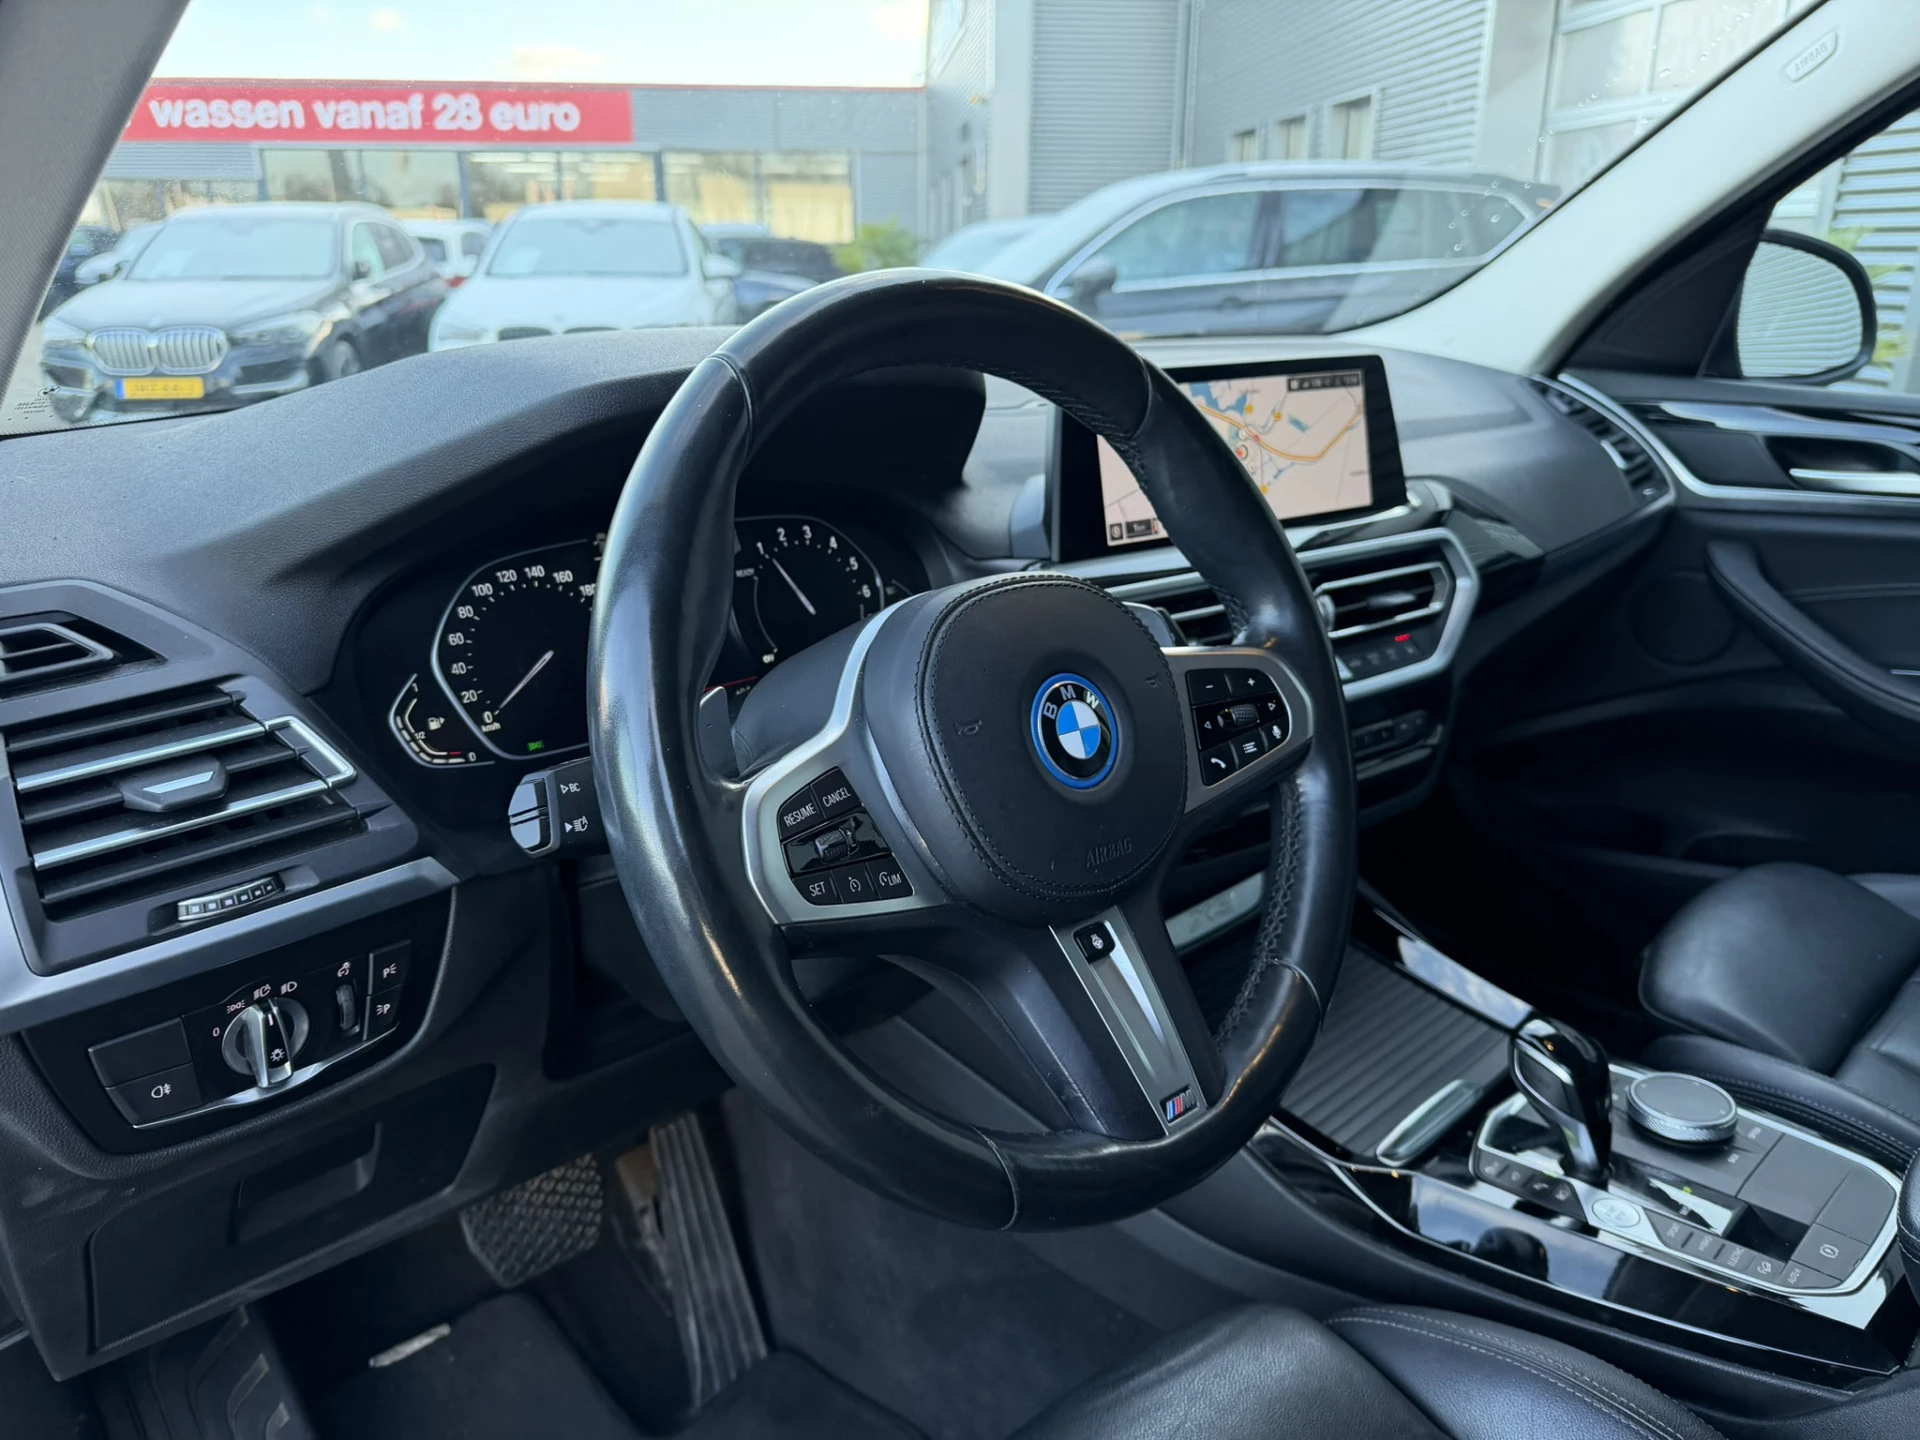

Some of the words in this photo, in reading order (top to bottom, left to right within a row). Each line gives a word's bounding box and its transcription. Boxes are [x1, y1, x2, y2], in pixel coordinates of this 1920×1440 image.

[1795, 42, 1828, 75] AIRBAG
[148, 99, 305, 128] wassen
[312, 93, 424, 130] vanaf
[432, 93, 483, 131] 28
[489, 101, 581, 132] euro
[776, 527, 787, 542] 2
[802, 525, 812, 539] 3
[756, 541, 765, 555] 1
[829, 535, 838, 550] 4
[849, 556, 859, 571] 5
[495, 569, 518, 583] 120
[524, 565, 546, 579] 140
[552, 570, 574, 584] 160
[471, 583, 493, 597] 100
[861, 584, 872, 598] 6
[457, 605, 474, 619] 80
[448, 632, 465, 646] 60
[451, 661, 467, 675] 40
[461, 689, 478, 704] 20
[1042, 684, 1100, 720] BMW
[482, 711, 493, 724] 0
[481, 722, 501, 733] km/h
[468, 751, 477, 762] 0
[568, 782, 581, 793] BC
[822, 786, 851, 808] CANCEL
[783, 802, 817, 828] RESUME
[1086, 837, 1133, 869] AIRBAG
[887, 871, 902, 887] LIM
[809, 881, 826, 897] SET
